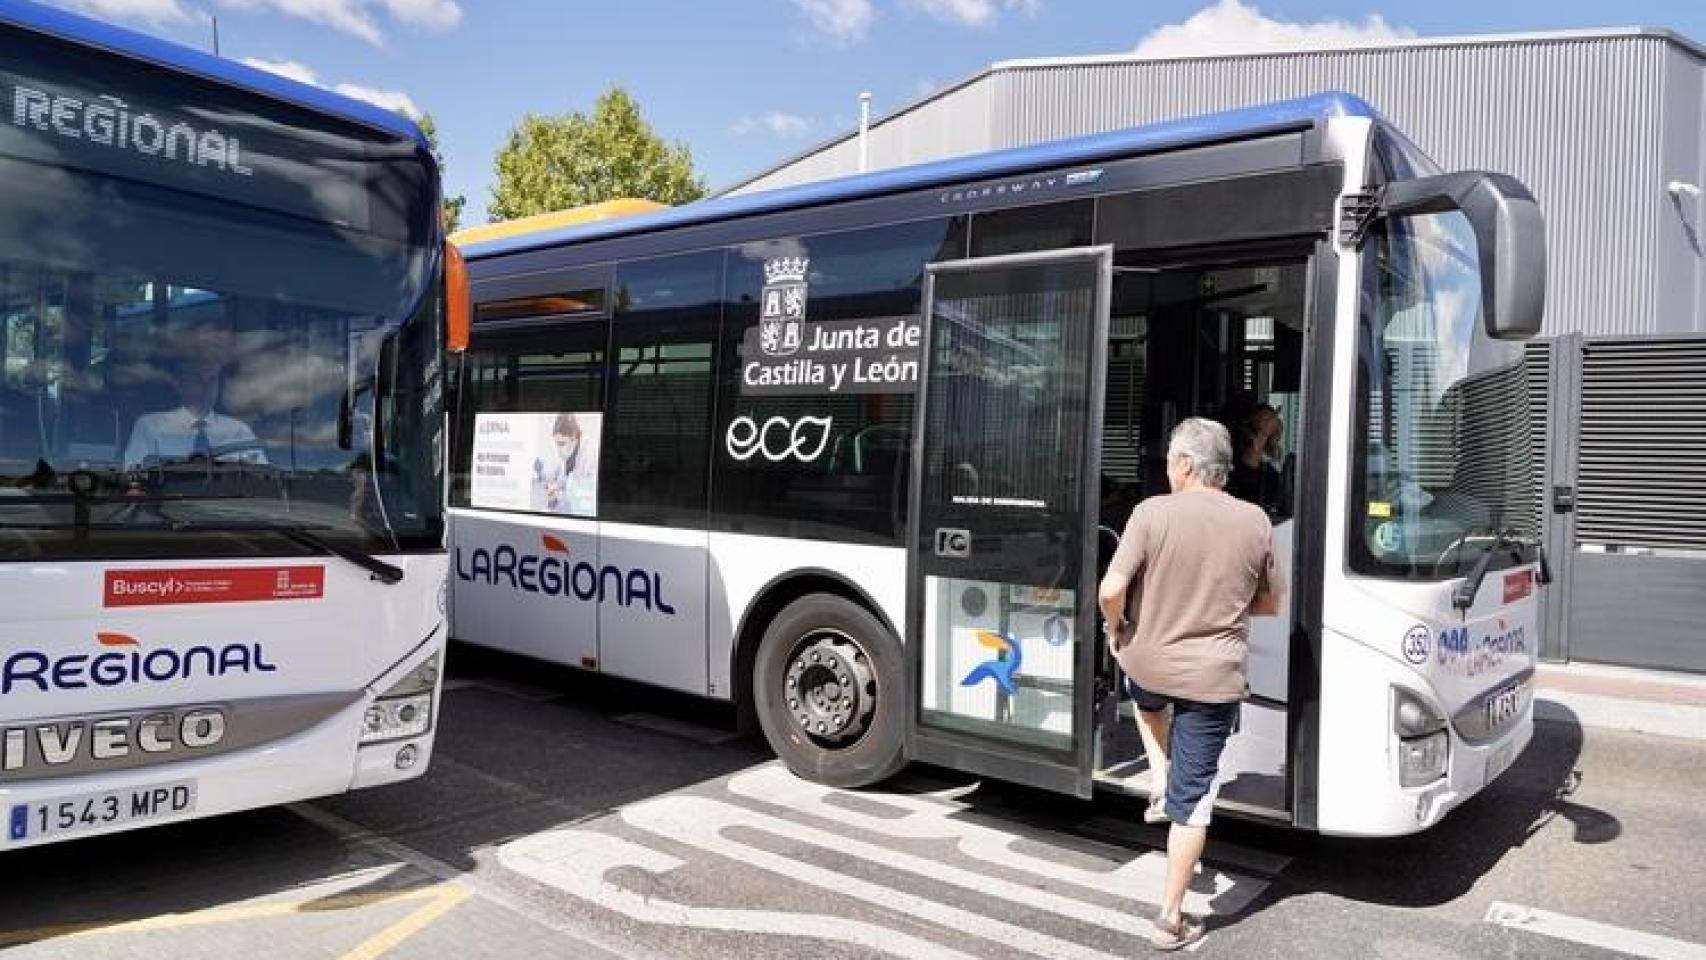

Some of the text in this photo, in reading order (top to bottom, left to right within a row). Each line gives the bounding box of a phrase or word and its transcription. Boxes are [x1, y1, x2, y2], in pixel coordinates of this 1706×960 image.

[807, 320, 920, 351] Junta de
[745, 355, 919, 391] Castilla y León
[726, 415, 833, 462] eco
[2, 707, 226, 770] IVECO
[38, 785, 190, 833] 1543 MPD
